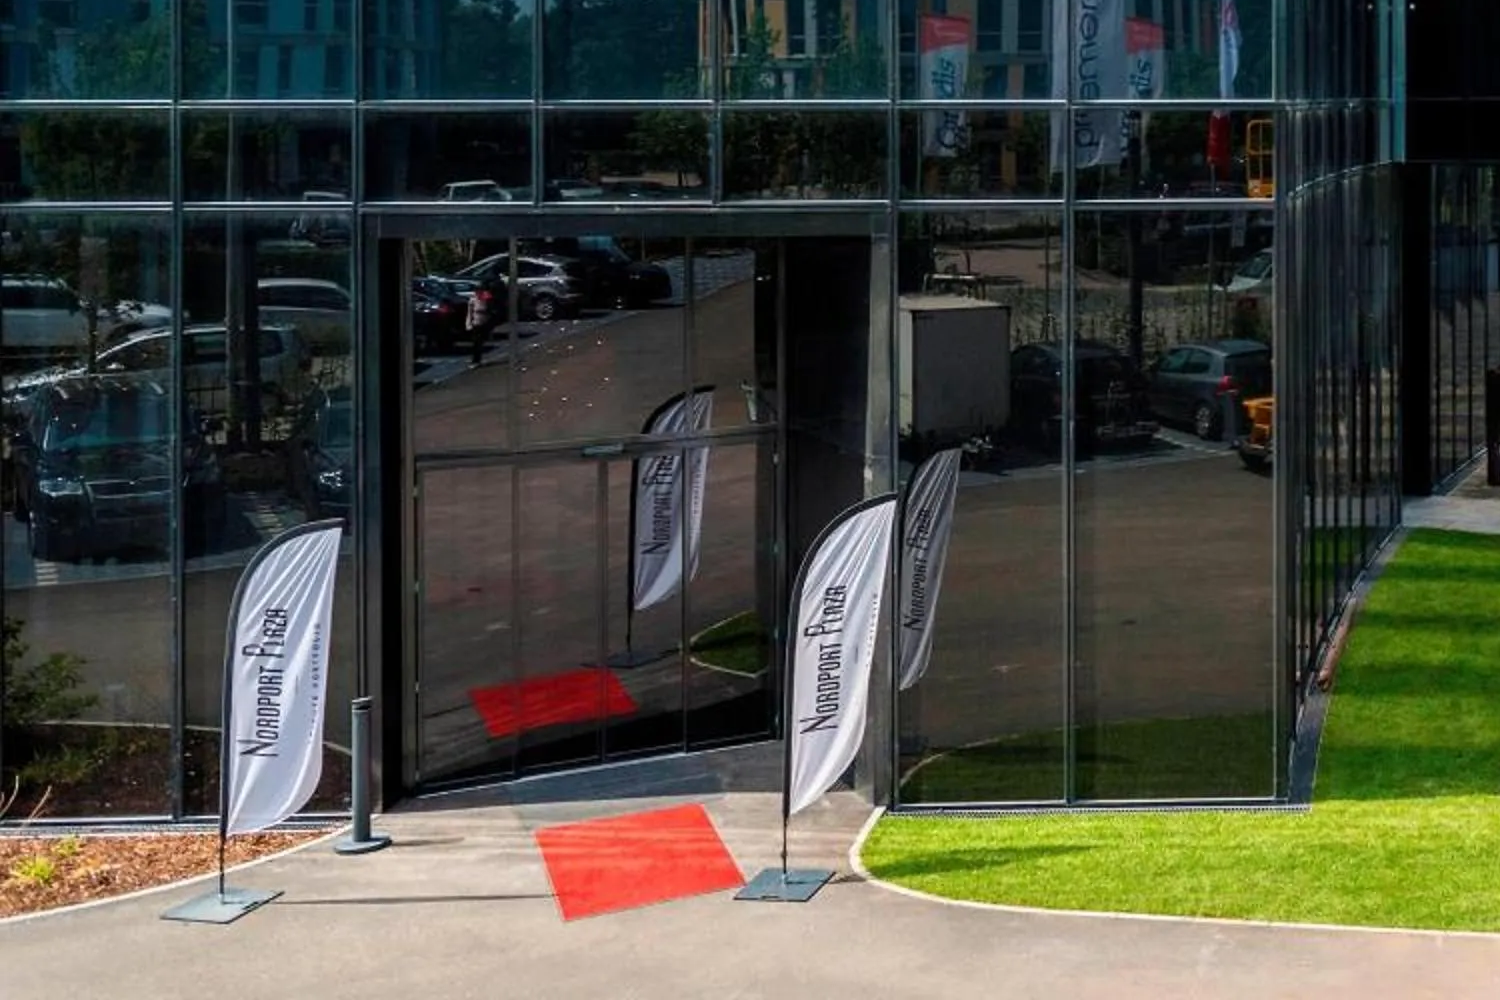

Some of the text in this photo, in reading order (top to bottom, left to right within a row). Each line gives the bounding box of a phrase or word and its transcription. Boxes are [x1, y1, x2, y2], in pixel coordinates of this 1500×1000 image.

[236, 608, 288, 757] NORDPORT PLAZA
[799, 585, 848, 734] NORDPORT PLAZA
